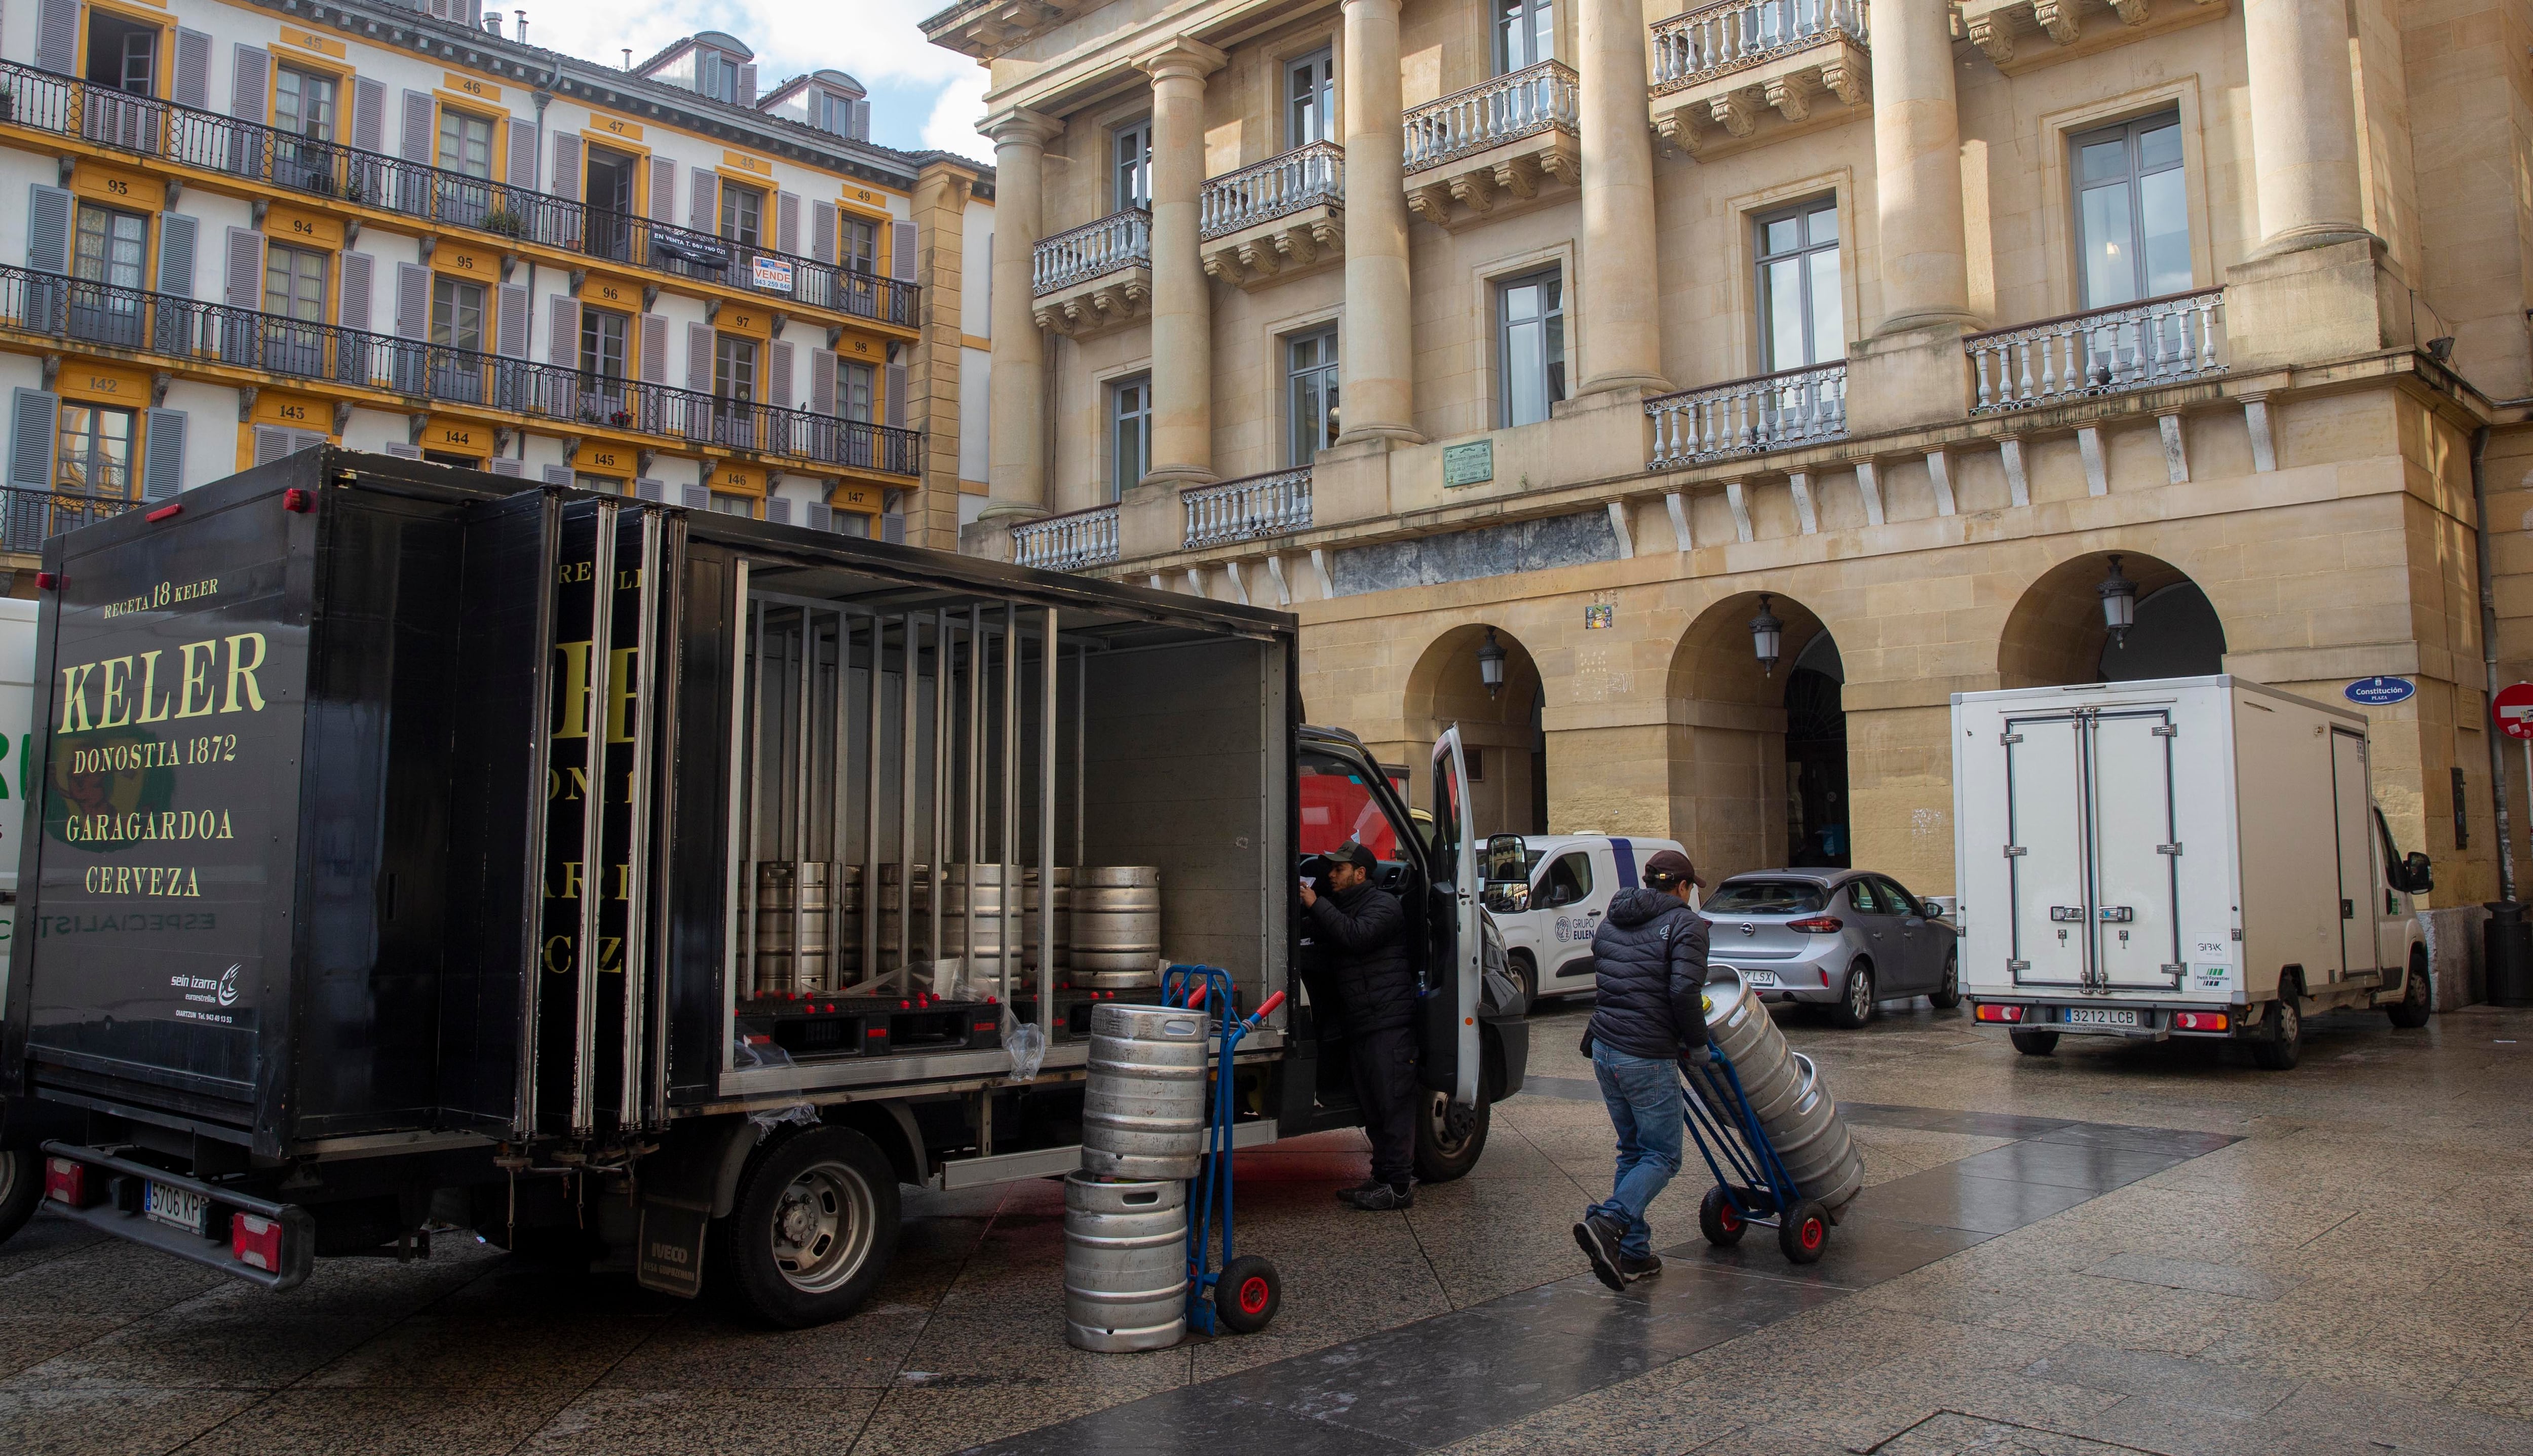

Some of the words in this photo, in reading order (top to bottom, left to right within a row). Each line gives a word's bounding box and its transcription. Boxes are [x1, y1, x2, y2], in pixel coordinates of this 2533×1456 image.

[303, 35, 323, 50] 45
[463, 80, 481, 95] 46
[609, 120, 625, 133] 47
[740, 157, 755, 170] 48
[107, 179, 128, 195] 93
[858, 190, 870, 202] 49
[293, 219, 314, 235] 94
[665, 235, 684, 246] VENTA
[716, 247, 726, 255] 021
[457, 256, 474, 269] 95
[755, 268, 790, 283] VENDE
[603, 287, 618, 300] 96
[736, 316, 749, 327] 97
[855, 341, 867, 353] 98
[89, 376, 118, 393] 142
[280, 405, 305, 420] 143
[445, 430, 469, 445] 144
[594, 452, 614, 466] 145
[727, 473, 746, 485] 146
[848, 491, 865, 503] 147
[104, 597, 149, 620] RECETA
[153, 582, 171, 608] 18
[174, 579, 218, 602] KELER
[57, 632, 267, 735] KELER
[2356, 686, 2403, 695] Constitución
[73, 740, 179, 774] DONOSTIA
[188, 734, 237, 764] 1872
[66, 809, 234, 842] GARAGARDOA
[86, 865, 201, 897] CERVEZA
[1572, 918, 1594, 929] GRUPO
[1573, 930, 1594, 940] EULEN
[171, 974, 189, 987] sein
[191, 975, 217, 990] izarra
[1753, 972, 1772, 982] LSX
[185, 993, 216, 1003] euroestrellas
[176, 1009, 197, 1019] OIARTZUN
[2074, 1010, 2105, 1022] 3212
[2109, 1011, 2133, 1024] LCB
[152, 1182, 180, 1217] 5706
[651, 1242, 687, 1264] IVECO
